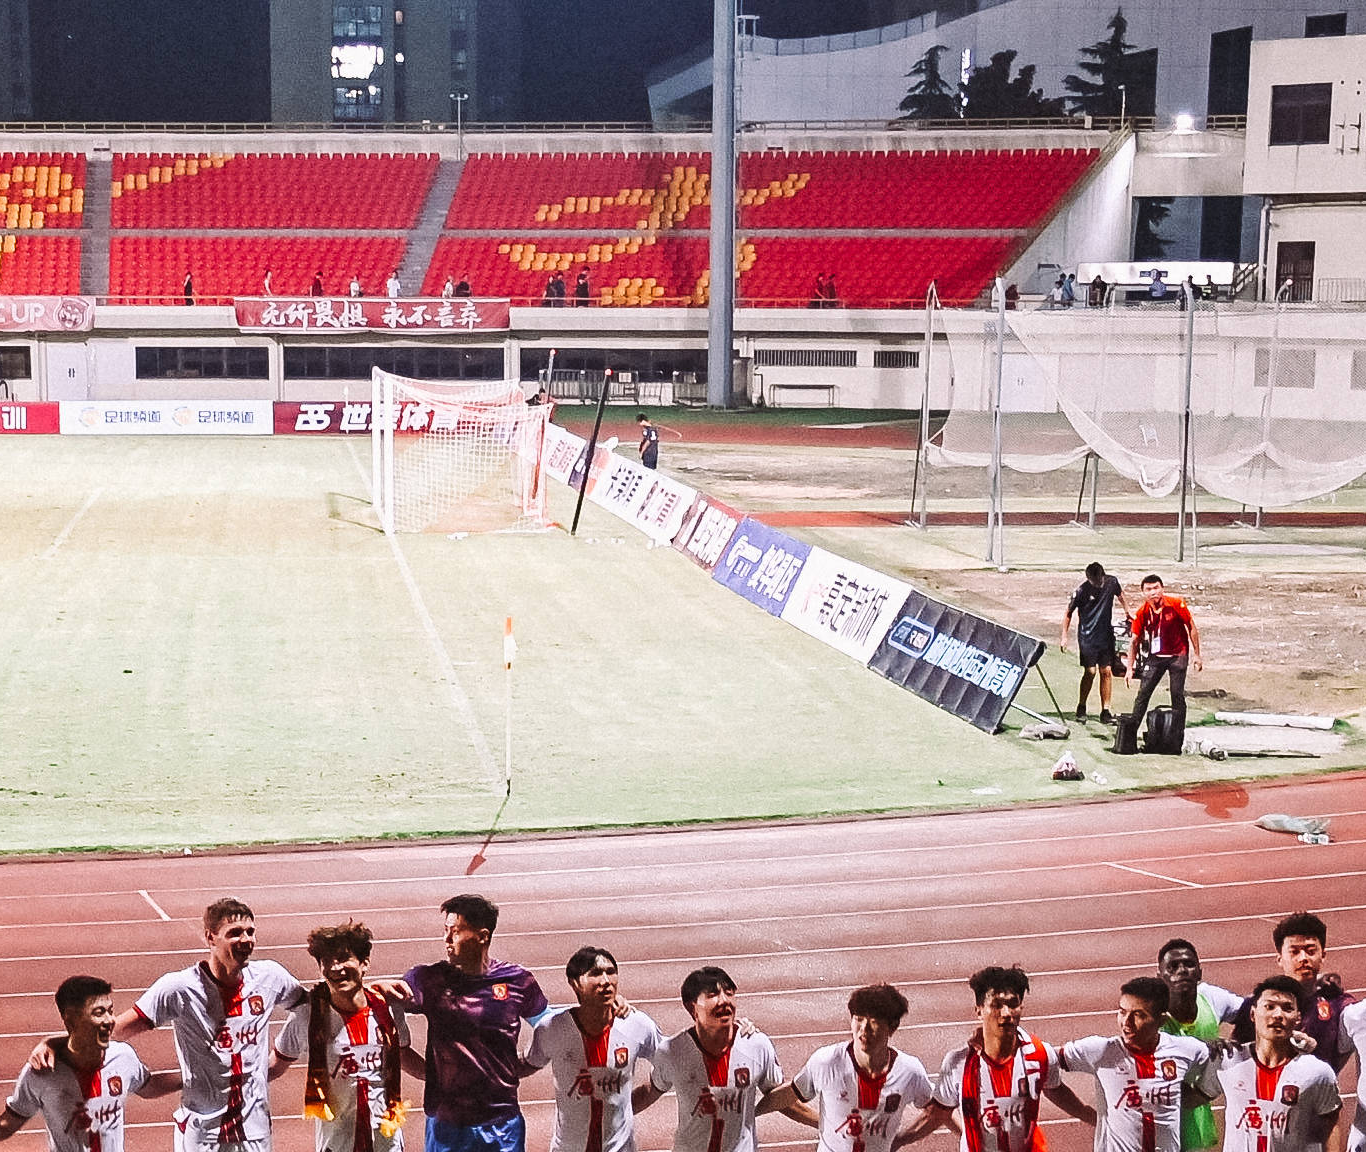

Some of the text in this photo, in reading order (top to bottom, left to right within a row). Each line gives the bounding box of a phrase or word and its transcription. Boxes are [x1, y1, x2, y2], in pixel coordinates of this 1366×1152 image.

[11, 302, 45, 324] UP
[261, 301, 482, 330] 无所畏惧 永不言弃
